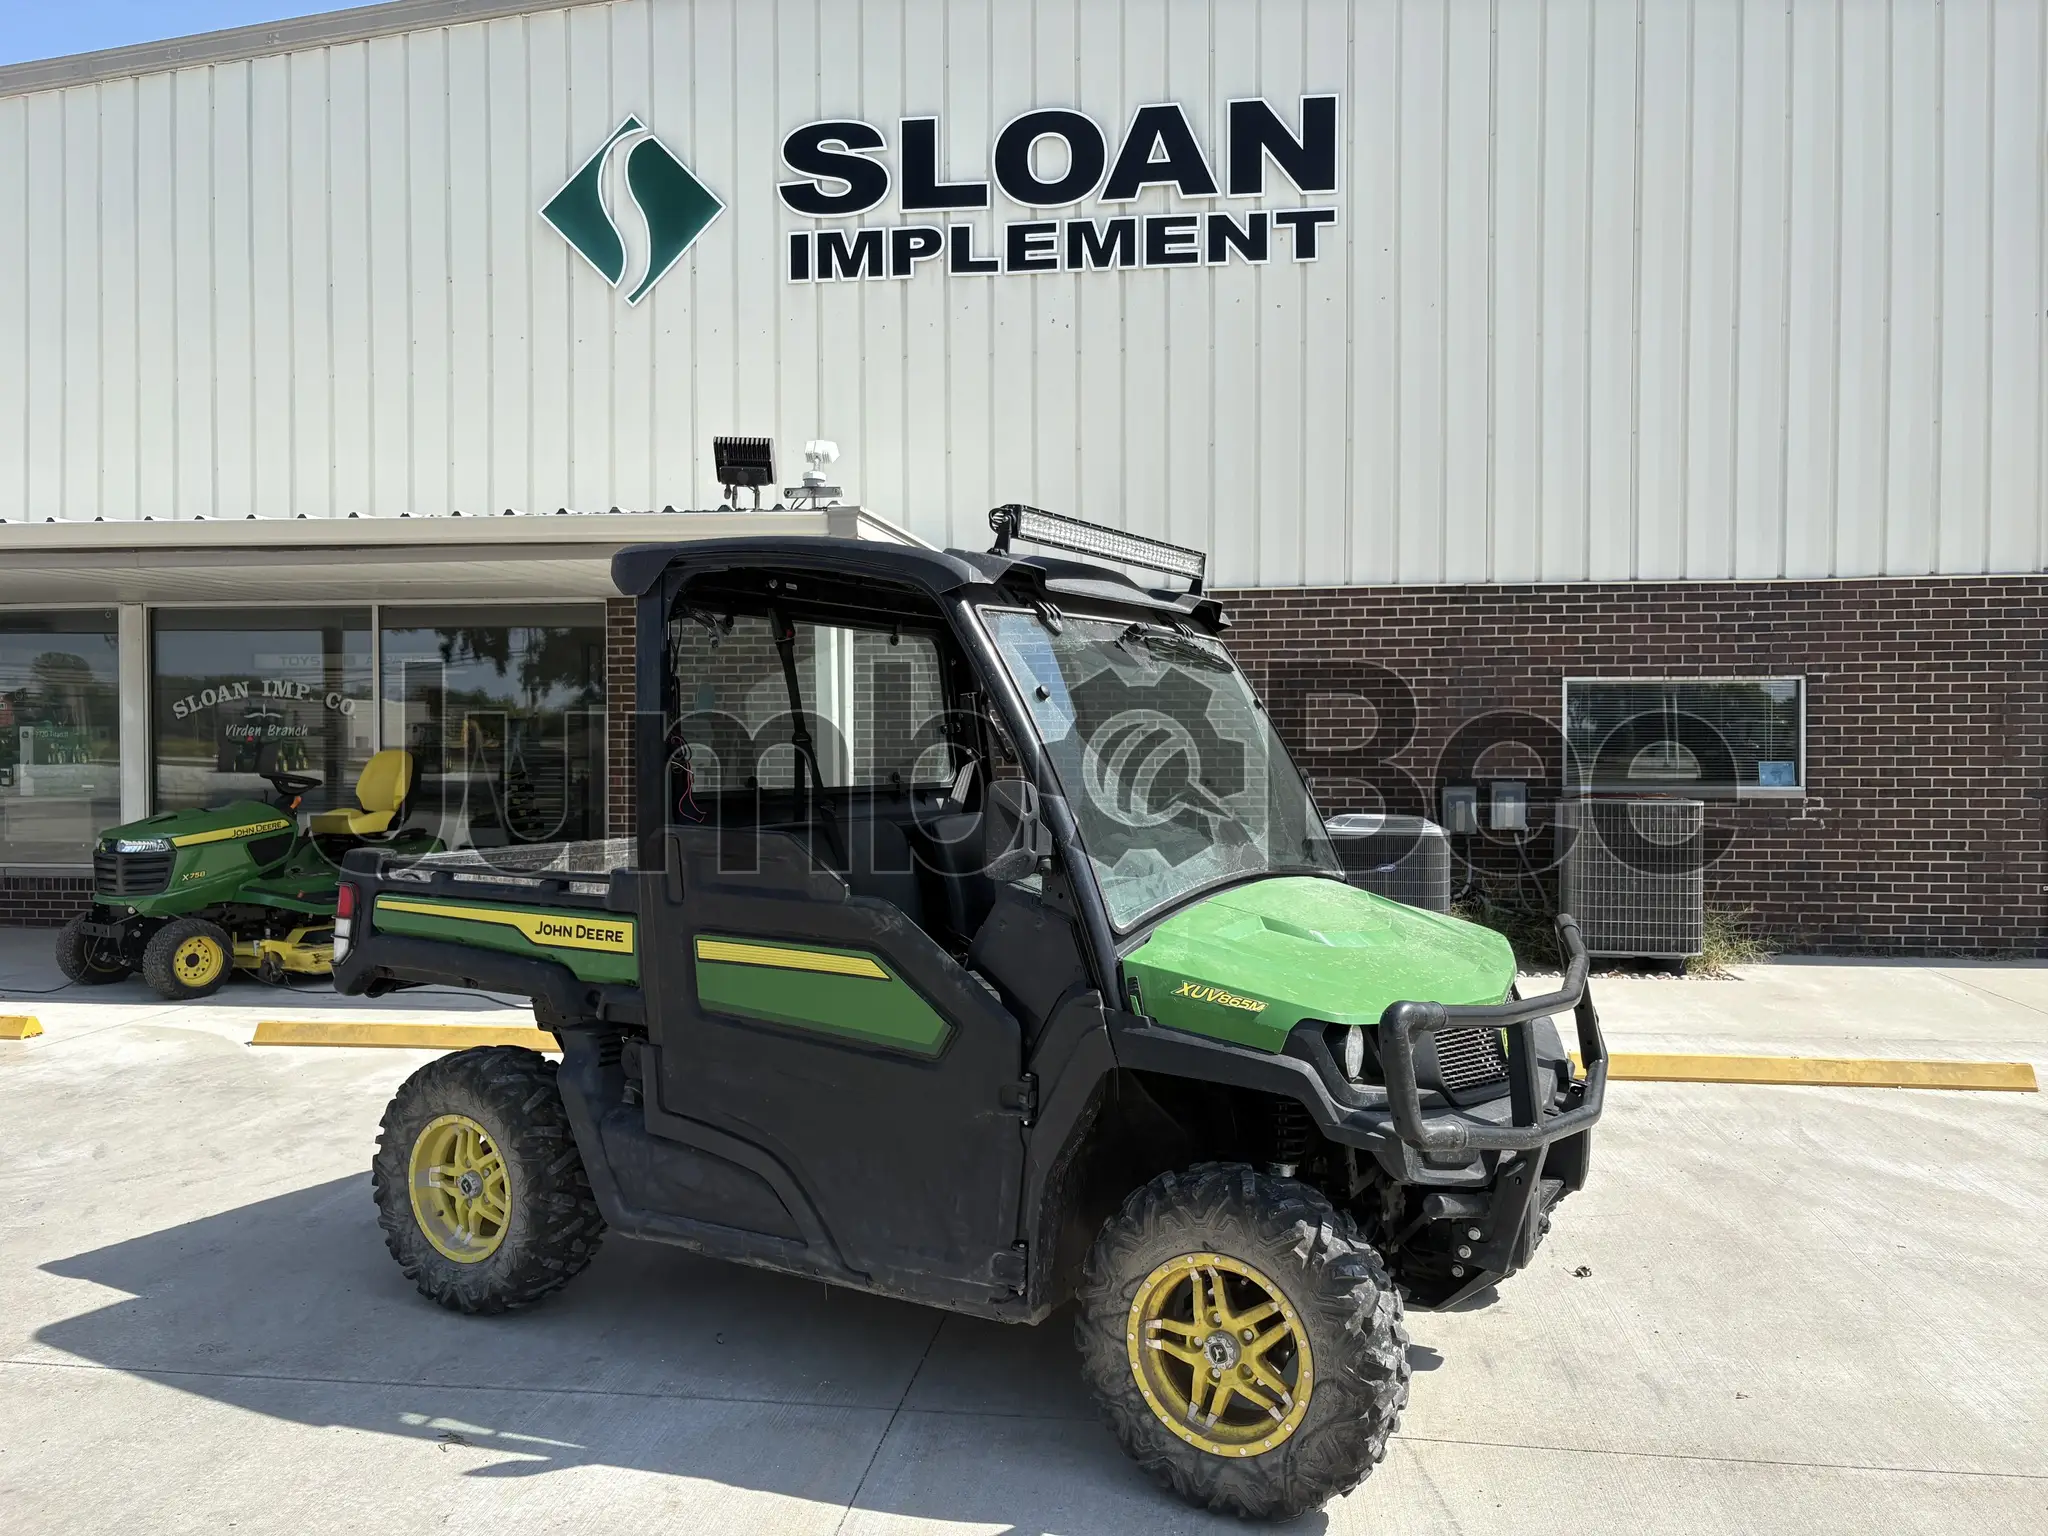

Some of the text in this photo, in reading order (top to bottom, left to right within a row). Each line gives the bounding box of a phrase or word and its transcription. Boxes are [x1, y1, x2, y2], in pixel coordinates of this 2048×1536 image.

[777, 93, 1340, 218] SLOAN
[787, 206, 1339, 284] IMPLEMENT
[172, 680, 249, 719] SLOAN
[261, 680, 314, 702] IMP.
[225, 724, 308, 737] Virden Branch
[231, 821, 282, 838] JOHN DEERE
[535, 921, 624, 943] JOHN DEERE
[1175, 981, 1269, 1013] XUV865M
